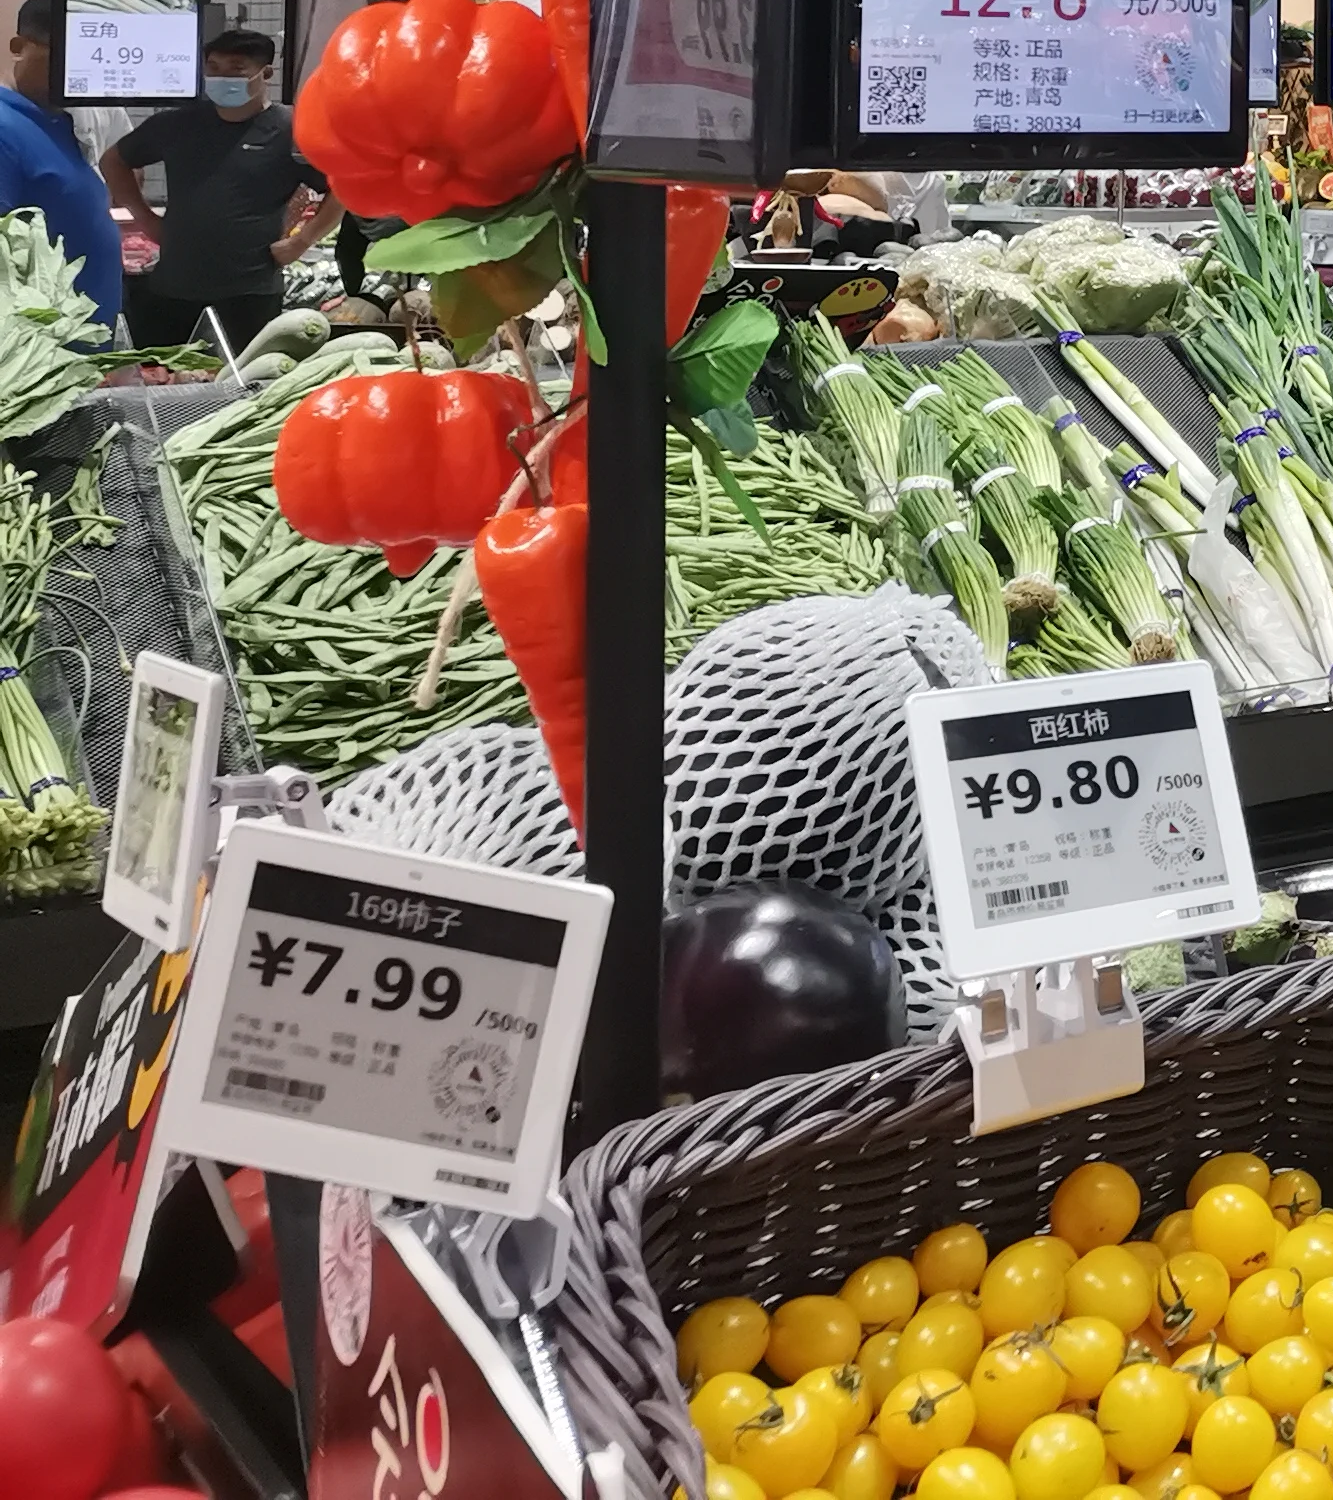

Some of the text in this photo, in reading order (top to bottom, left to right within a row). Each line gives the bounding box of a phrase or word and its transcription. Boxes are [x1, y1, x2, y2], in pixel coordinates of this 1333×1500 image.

[79, 22, 118, 38] 豆角
[91, 47, 144, 64] 4.99
[1028, 708, 1110, 745] 西红柿
[961, 755, 1203, 821] ¥9.80 /500g
[346, 890, 463, 940] 169柿子
[247, 930, 539, 1041] ¥7.99 /500g
